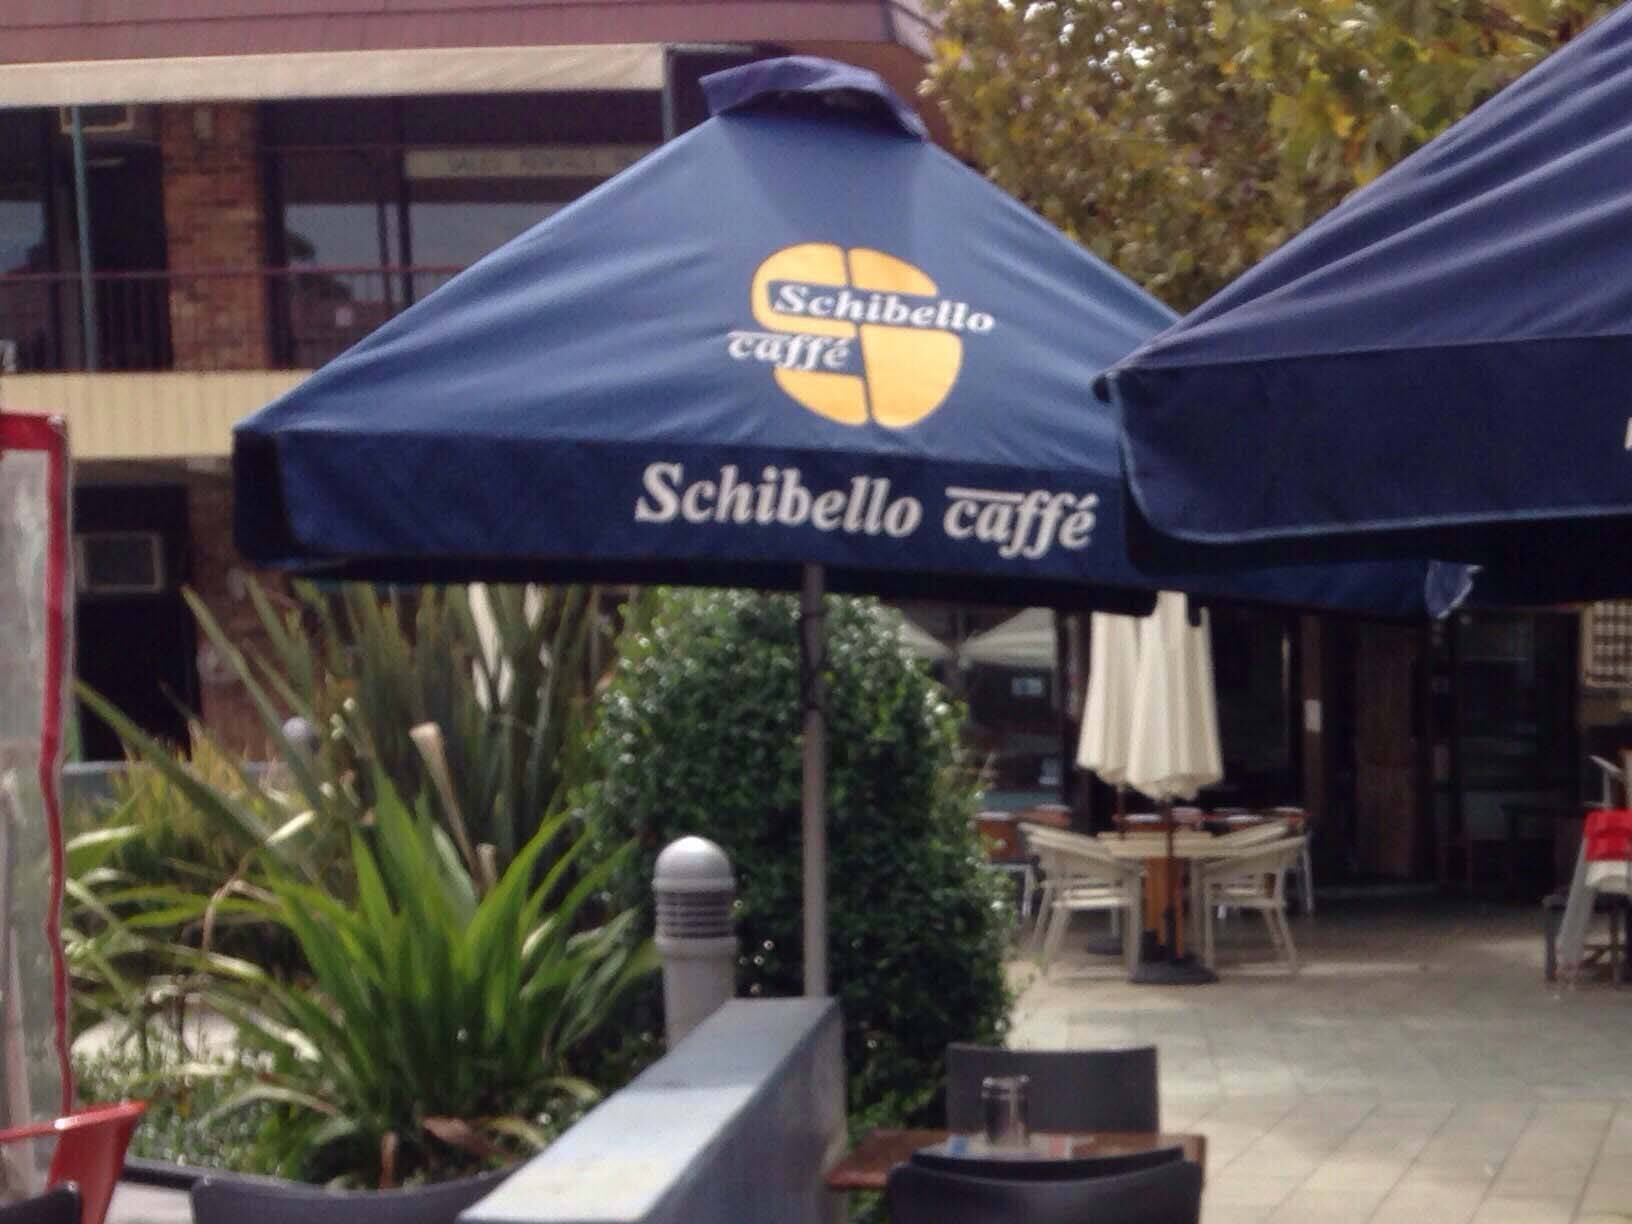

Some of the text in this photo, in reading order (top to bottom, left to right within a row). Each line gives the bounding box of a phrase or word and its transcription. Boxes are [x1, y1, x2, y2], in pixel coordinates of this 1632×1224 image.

[773, 283, 997, 334] Schibello
[726, 331, 856, 371] caffé
[635, 461, 1098, 559] Schibello caffé
